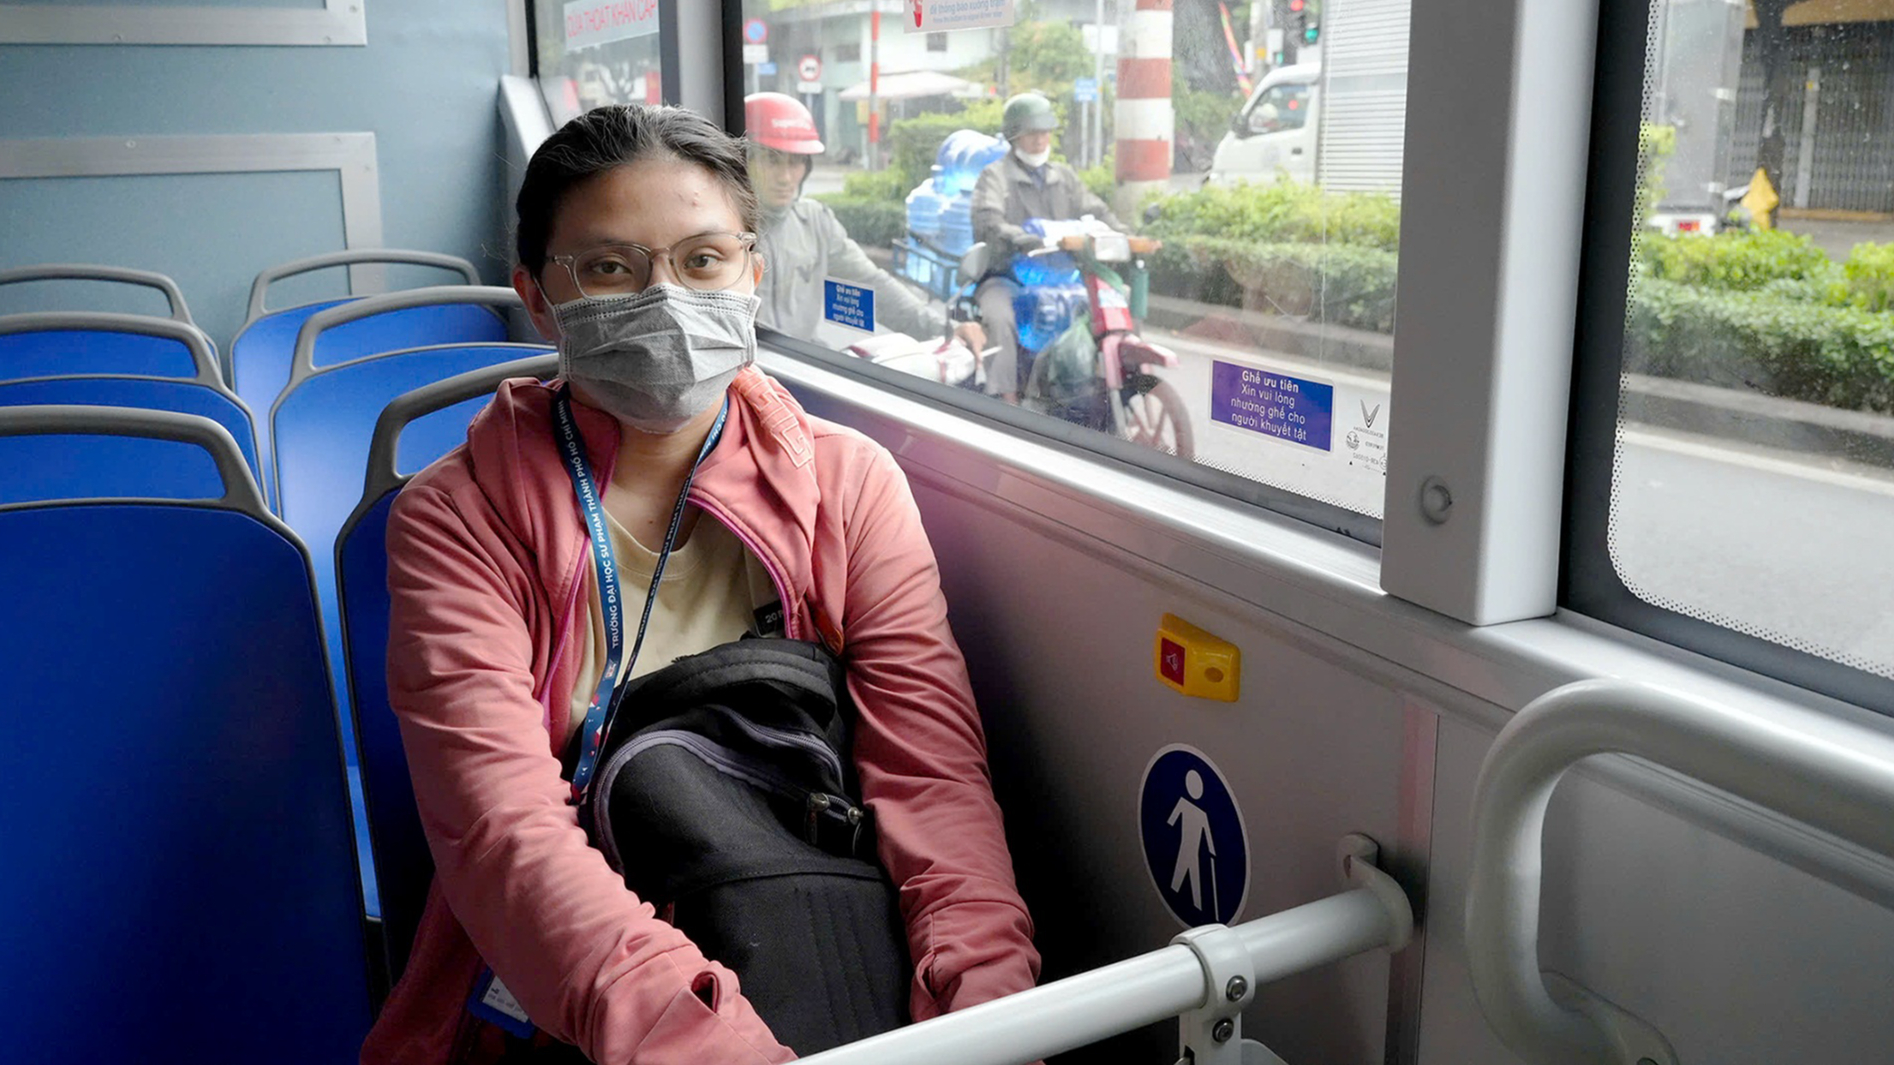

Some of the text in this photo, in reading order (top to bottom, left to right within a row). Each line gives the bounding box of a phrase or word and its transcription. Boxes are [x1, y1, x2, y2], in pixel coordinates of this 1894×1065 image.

[1242, 370, 1299, 394] Ghế ưu tiên
[1241, 384, 1295, 409] Xin vui lòng
[1230, 398, 1306, 425] nhường ghế cho
[1231, 413, 1307, 441] người khuyết tật
[580, 479, 597, 512] THÀNH
[591, 513, 606, 543] PHẠM
[602, 560, 615, 584] HỌC
[606, 585, 618, 604] ĐẠI
